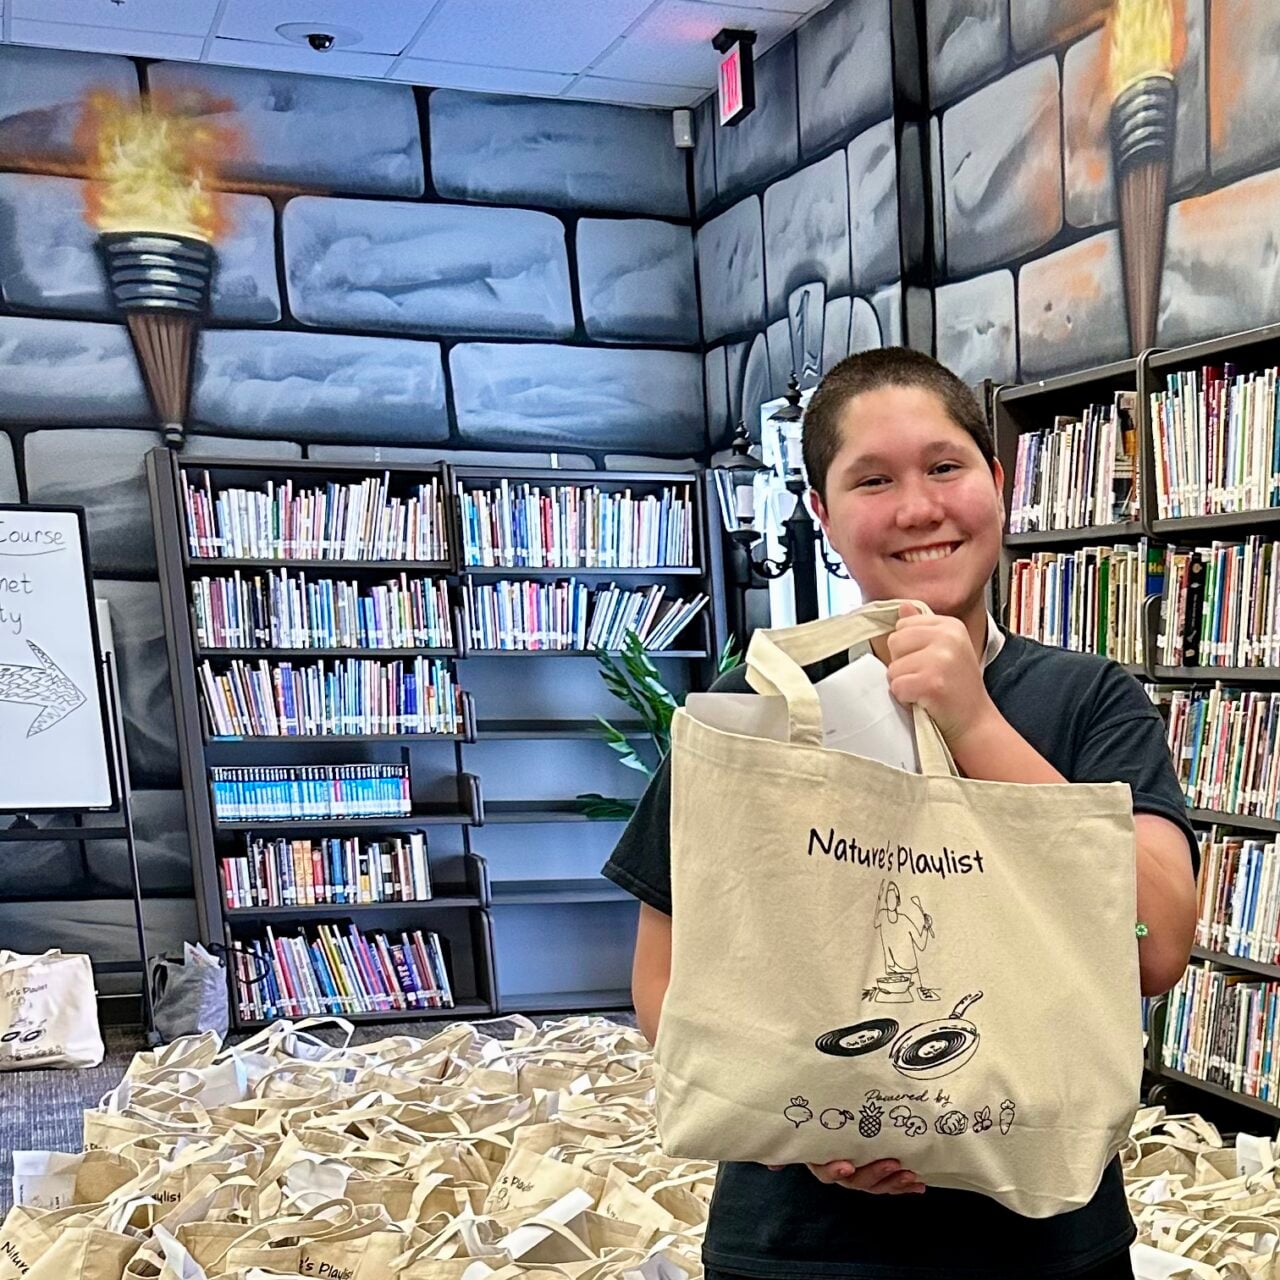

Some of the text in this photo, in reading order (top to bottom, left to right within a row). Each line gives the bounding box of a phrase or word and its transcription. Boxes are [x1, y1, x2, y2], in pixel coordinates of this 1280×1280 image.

[808, 828, 985, 879] Nature's Playlist
[864, 1089, 952, 1106] Powered by
